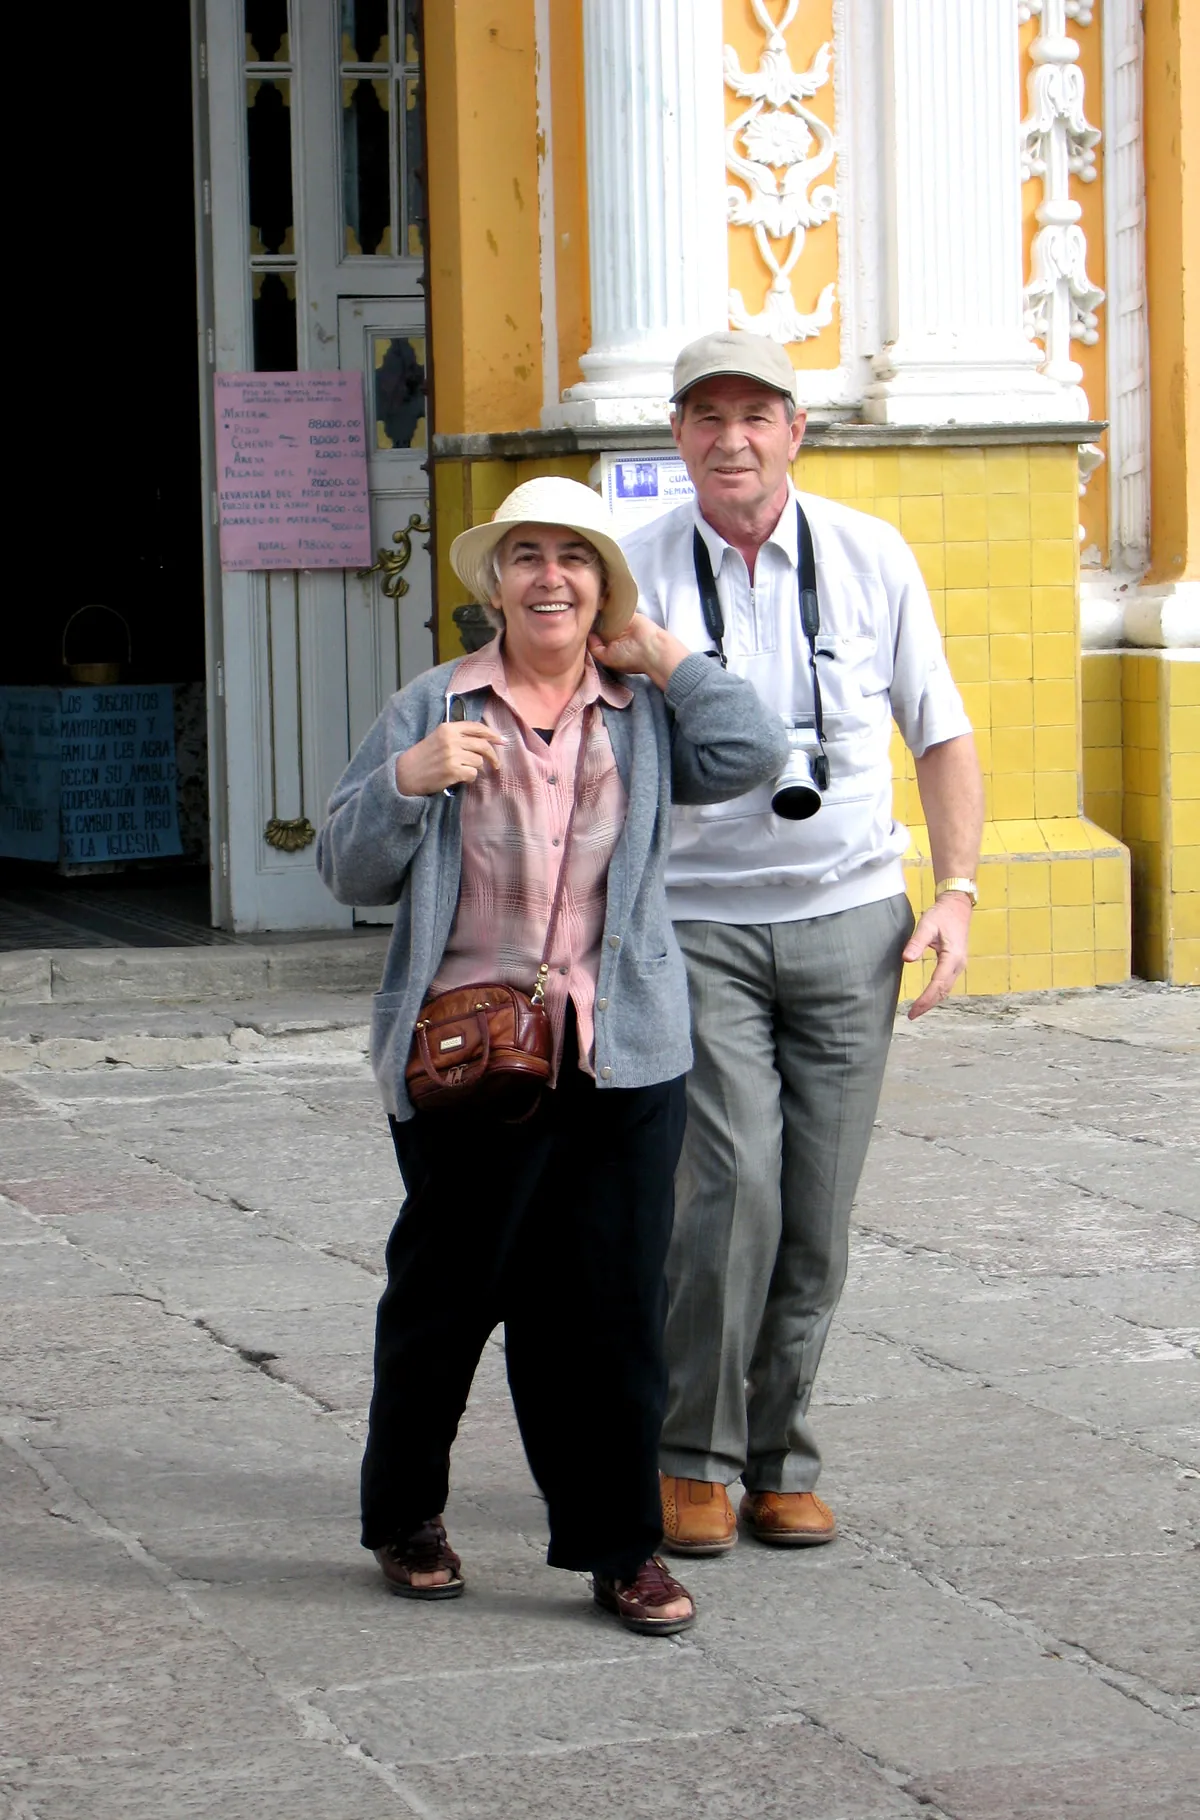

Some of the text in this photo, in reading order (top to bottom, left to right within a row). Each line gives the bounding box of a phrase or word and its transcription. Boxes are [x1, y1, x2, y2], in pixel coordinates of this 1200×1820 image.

[231, 435, 274, 450] CEMENTO
[663, 486, 695, 496] SEMAN
[61, 695, 82, 715] LOS
[93, 692, 159, 713] SUSCRITOS
[61, 718, 137, 738] MAYORDOMOS
[146, 716, 156, 735] Y
[61, 744, 107, 763] FAMILIA
[113, 741, 135, 760] LES
[61, 767, 99, 786] DECEN
[105, 764, 122, 784] SU
[129, 762, 177, 783] AMABLE
[61, 783, 136, 810] COOPERACIÓN
[143, 785, 171, 807] PARA
[75, 813, 112, 834] CAMBIO
[117, 812, 137, 830] DEL
[144, 810, 171, 830] PISO
[80, 837, 96, 858] LA
[107, 833, 161, 856] IGLESIA
